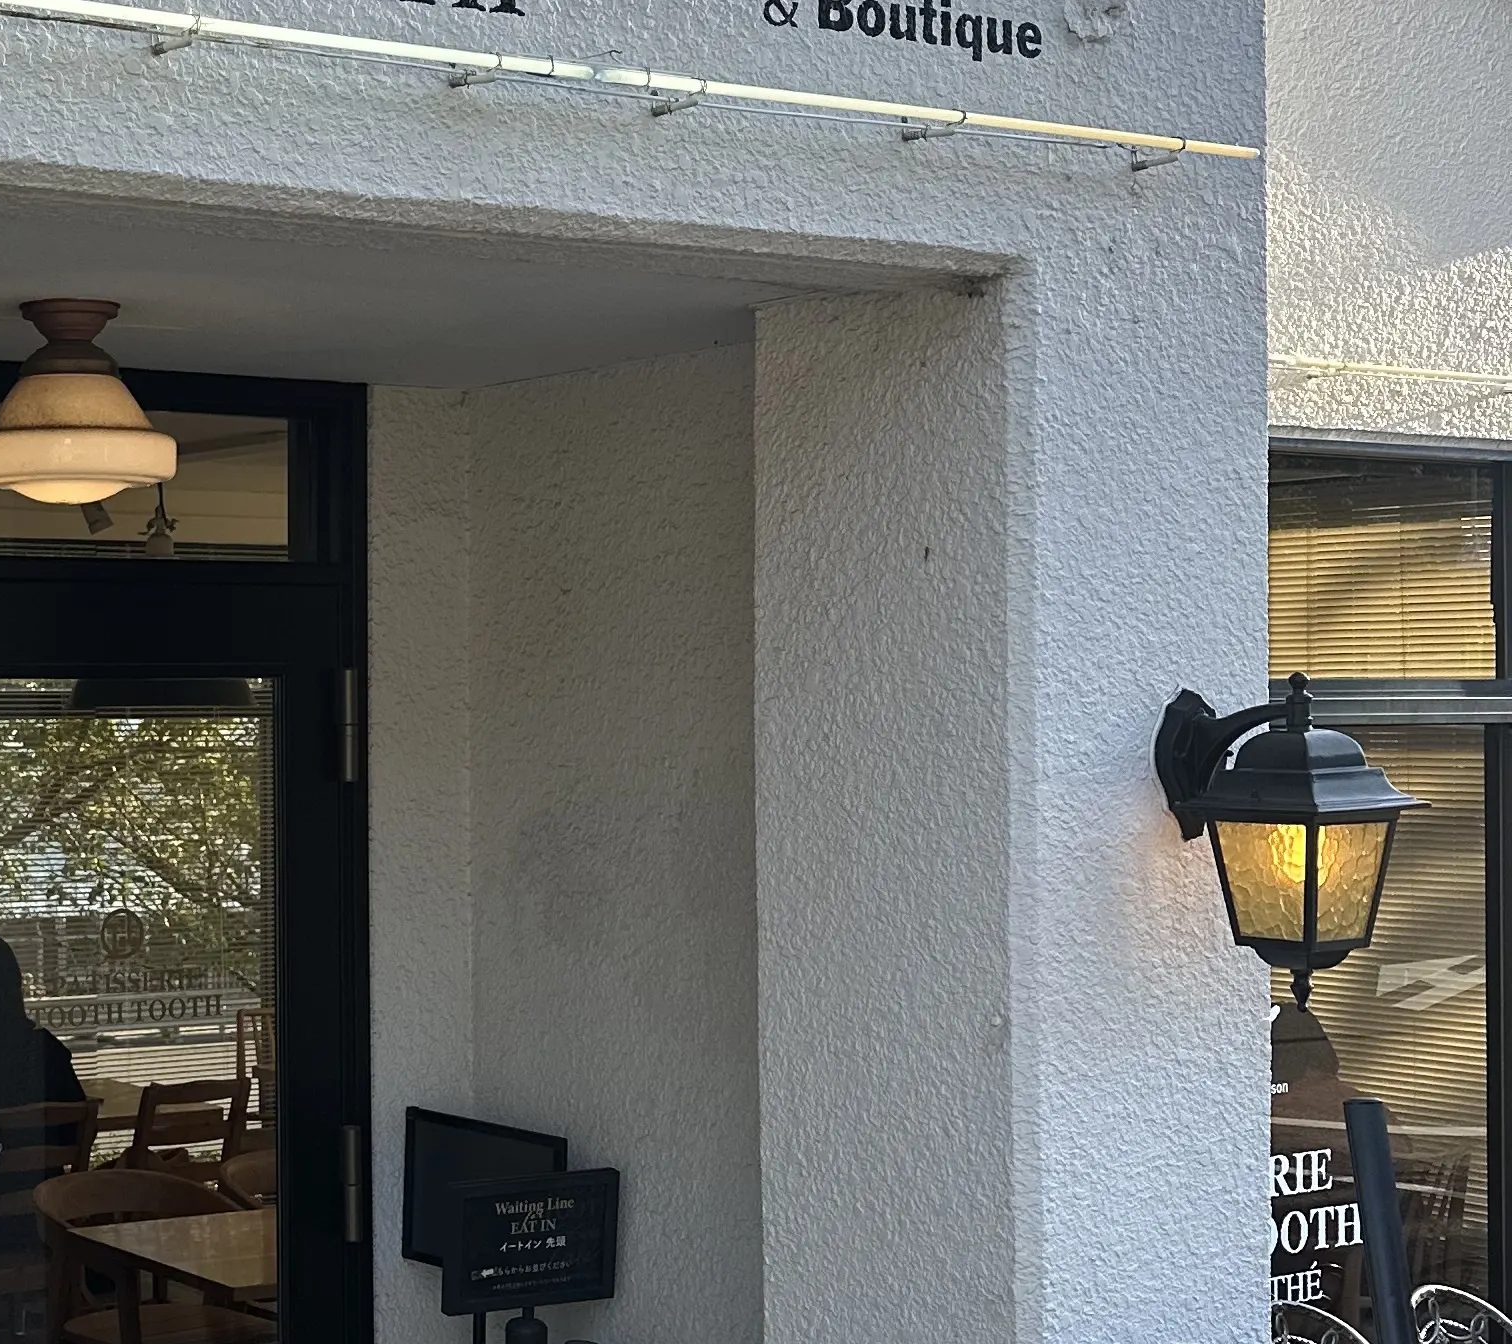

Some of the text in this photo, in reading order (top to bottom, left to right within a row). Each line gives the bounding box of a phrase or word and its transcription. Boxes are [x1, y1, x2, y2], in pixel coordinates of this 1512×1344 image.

[33, 994, 223, 1029] TOOTH TOOTH
[1271, 1082, 1289, 1095] son
[1270, 1148, 1333, 1197] RIE
[495, 1196, 575, 1216] Waiting Line
[510, 1217, 557, 1235] EAT IN
[1270, 1203, 1364, 1255] OTH
[499, 1235, 567, 1253] イートイン 先頭
